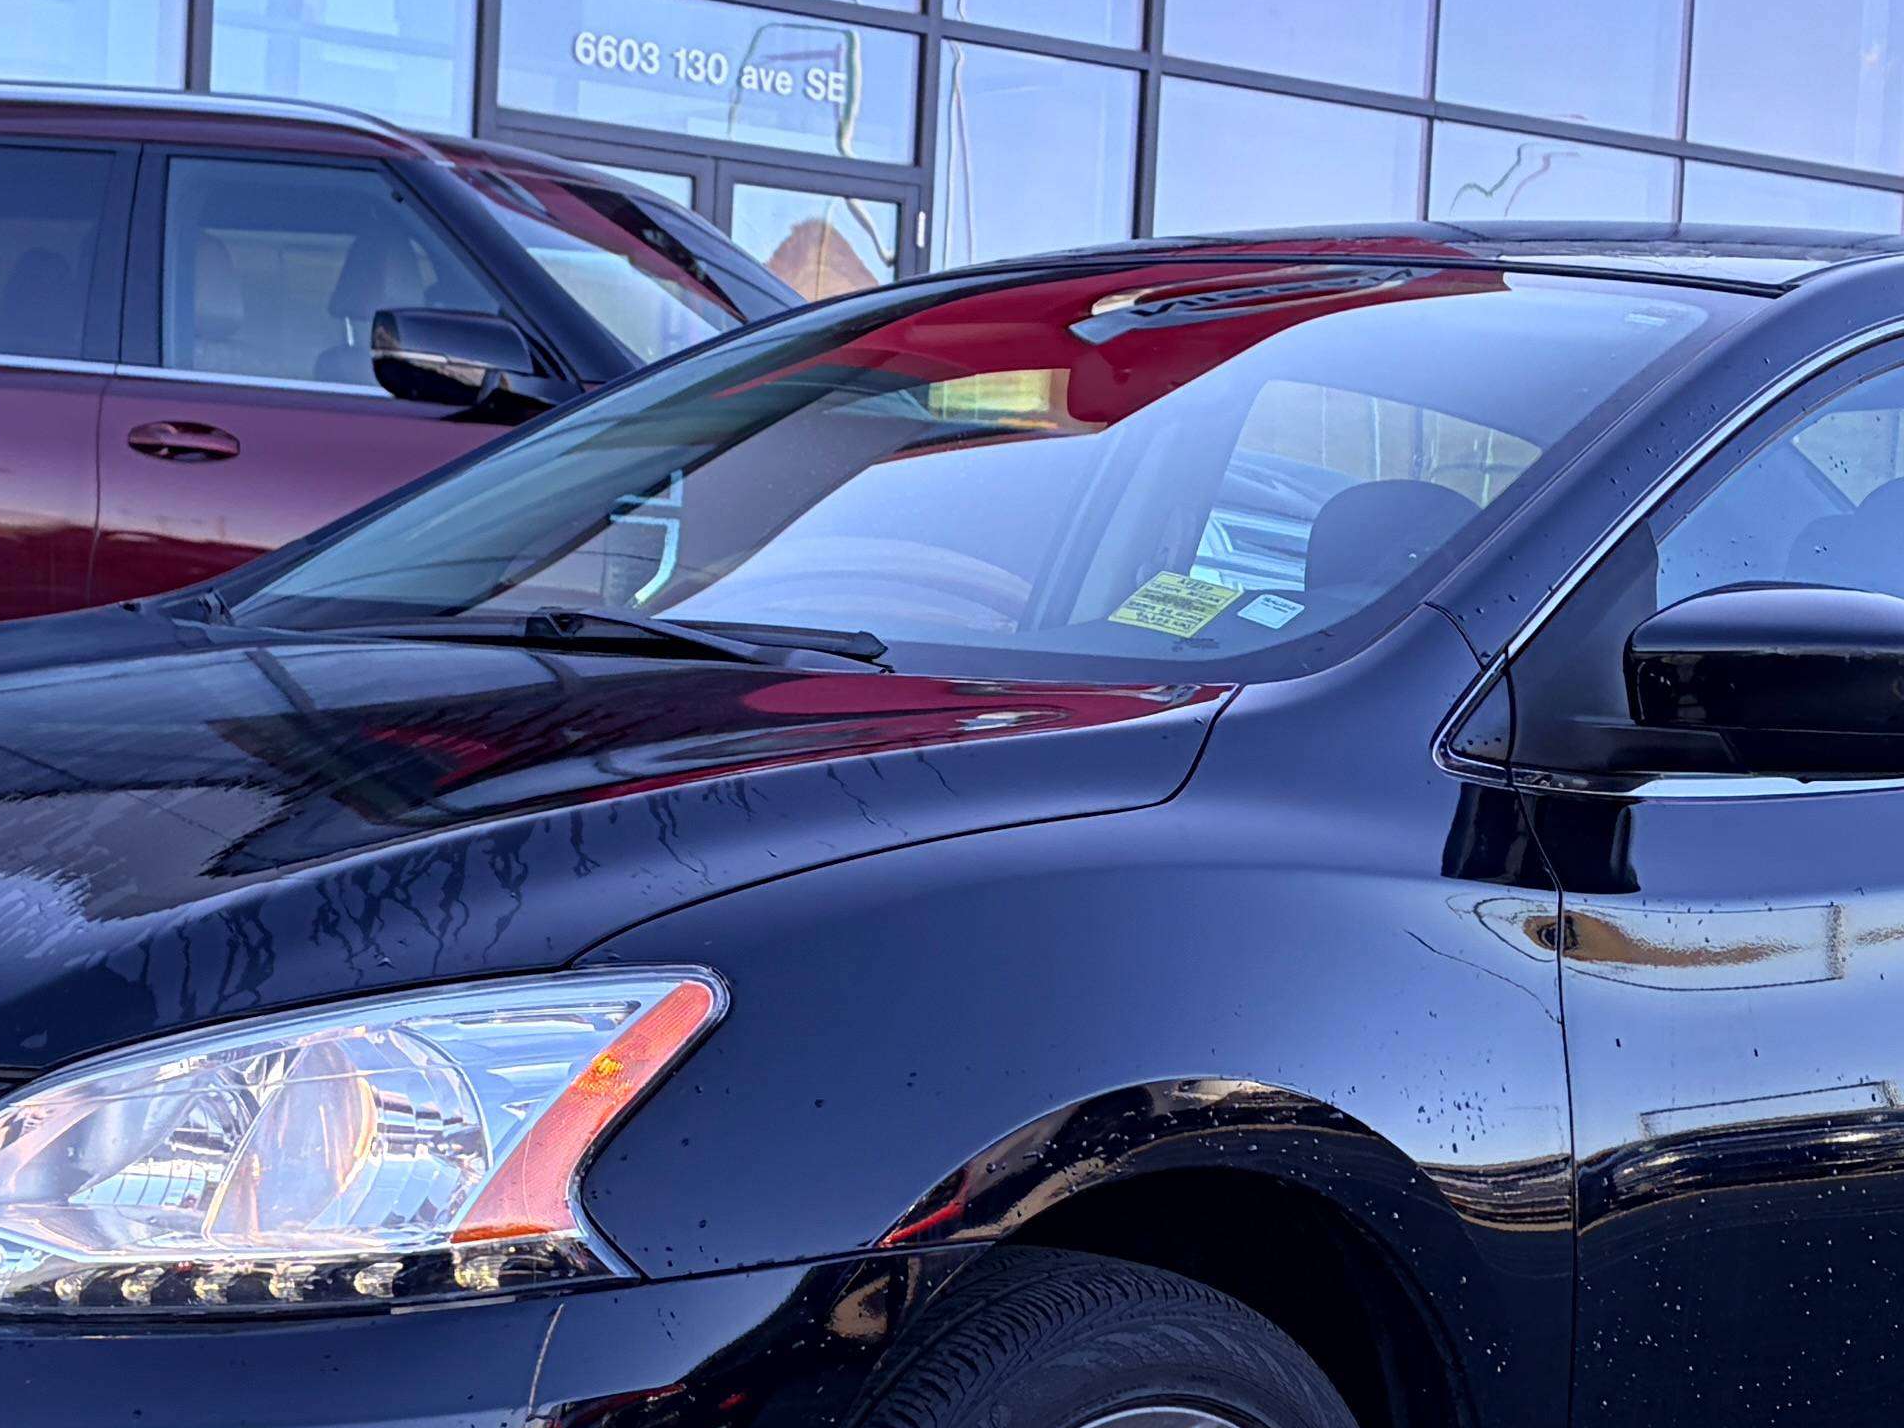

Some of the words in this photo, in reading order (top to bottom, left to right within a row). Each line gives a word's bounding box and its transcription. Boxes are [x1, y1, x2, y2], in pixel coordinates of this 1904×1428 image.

[575, 31, 660, 74] 6603
[673, 47, 728, 85] 130
[740, 65, 793, 95] ave
[806, 67, 847, 103] SE
